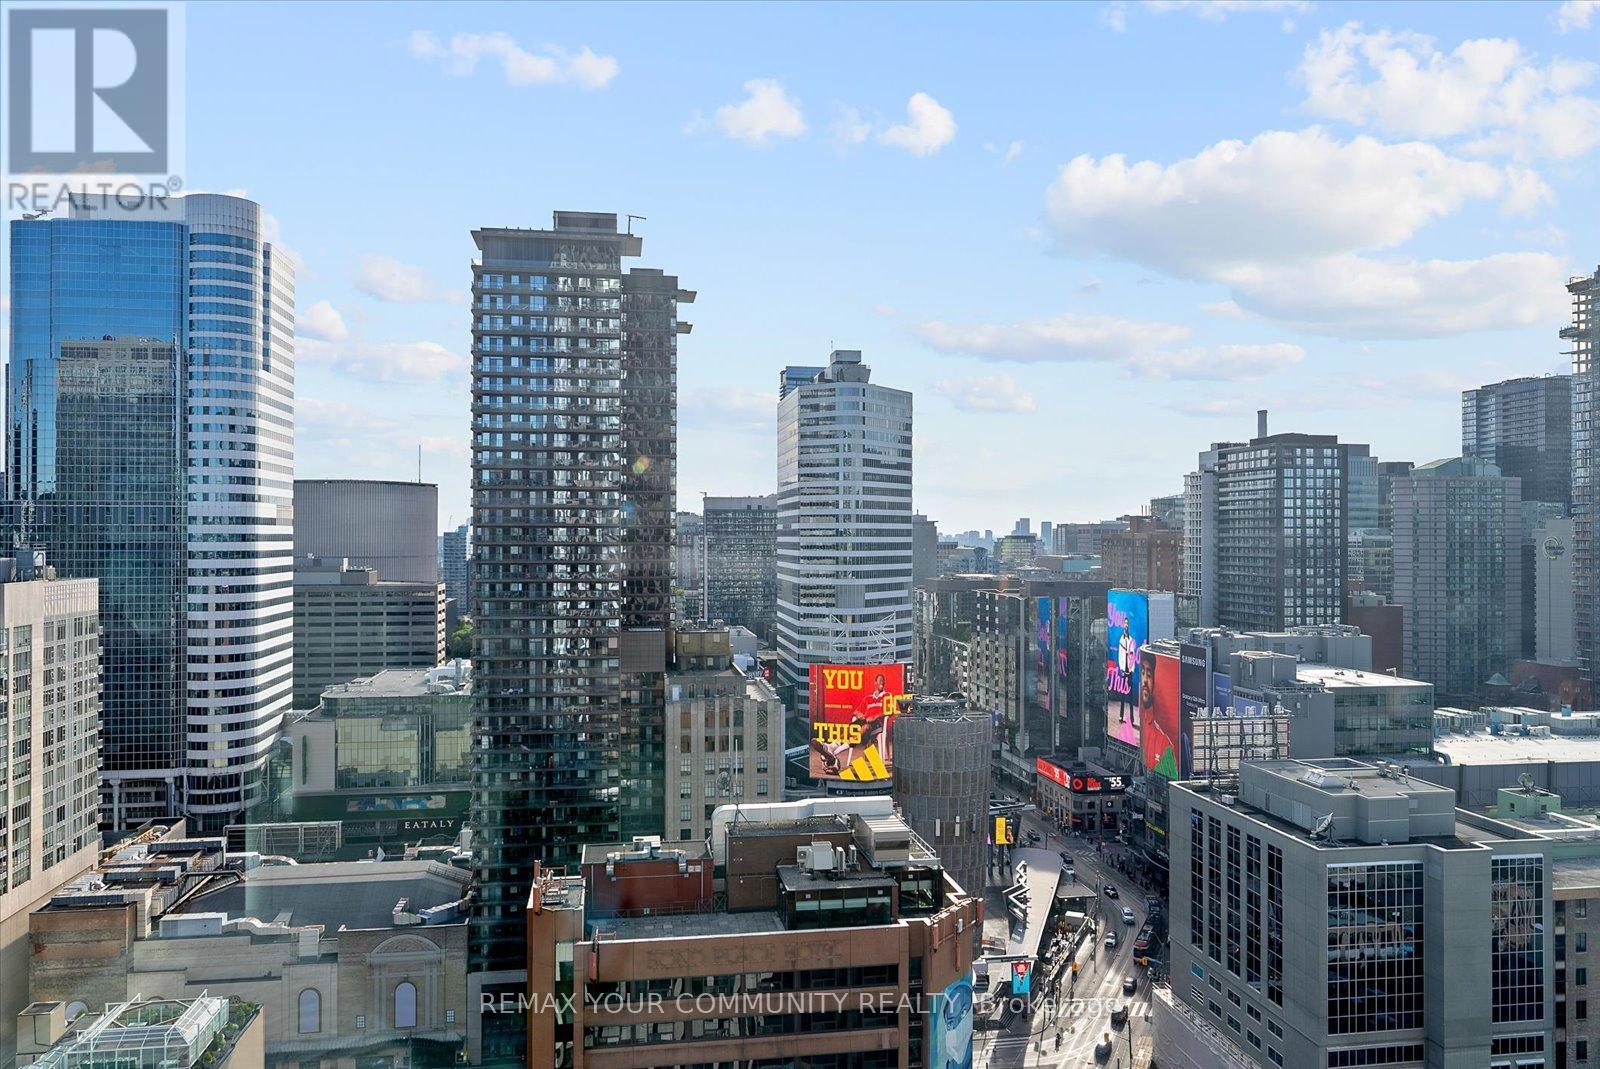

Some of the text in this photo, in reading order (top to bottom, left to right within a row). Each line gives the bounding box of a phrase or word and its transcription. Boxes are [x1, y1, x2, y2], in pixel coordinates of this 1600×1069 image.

[1182, 655, 1206, 668] SAMSUNG
[823, 669, 864, 690] YOU
[814, 722, 862, 744] THIS
[404, 820, 454, 830] EATALY
